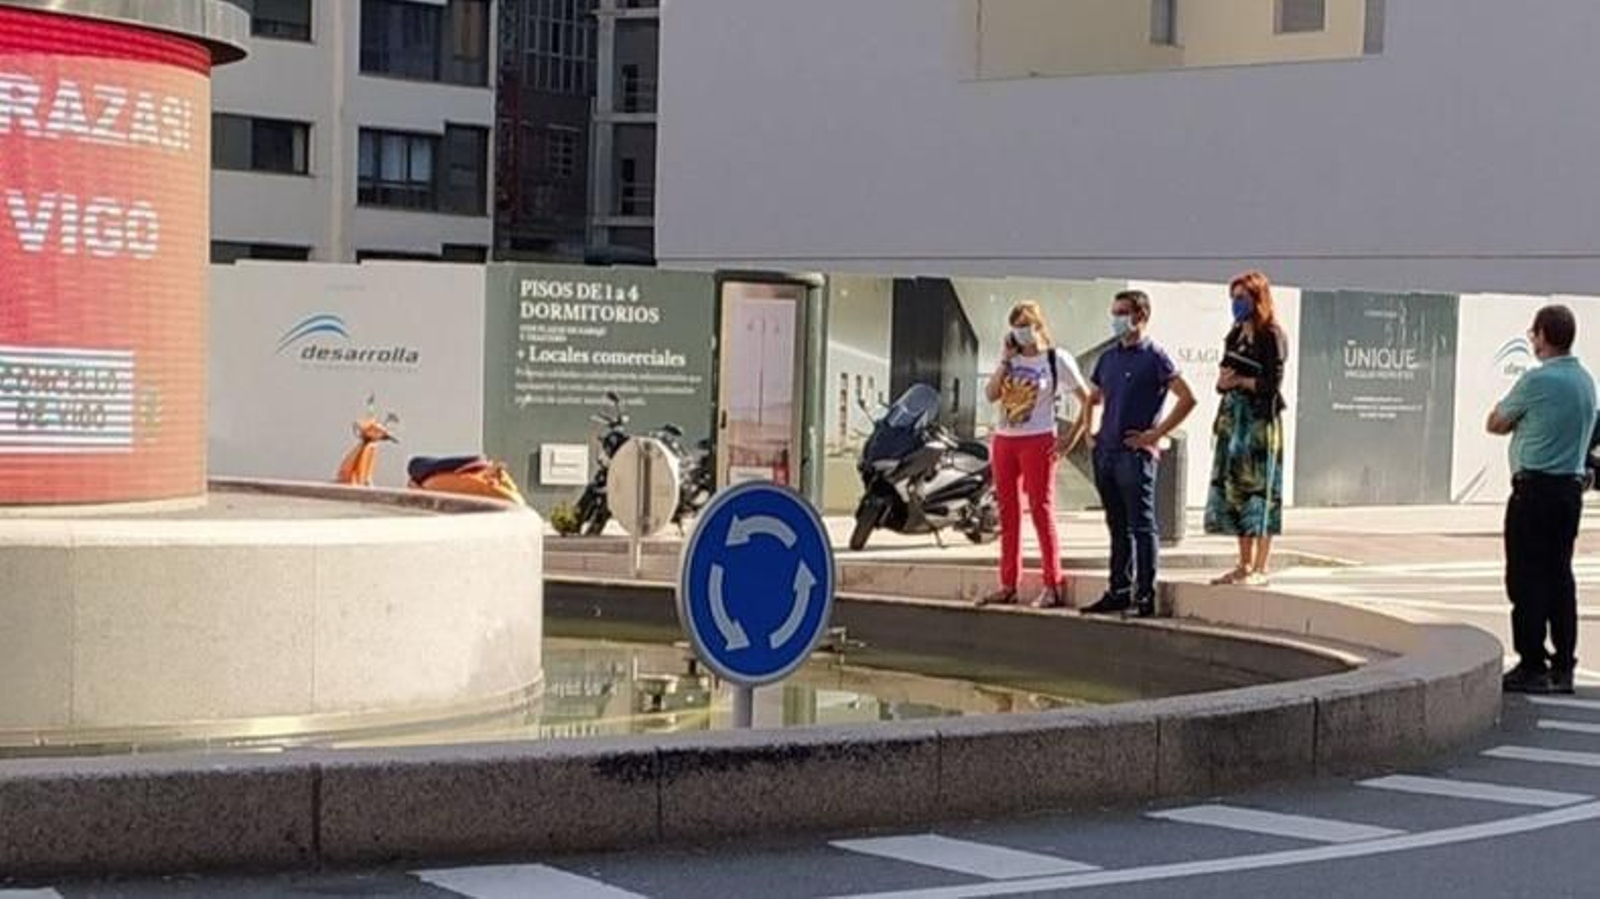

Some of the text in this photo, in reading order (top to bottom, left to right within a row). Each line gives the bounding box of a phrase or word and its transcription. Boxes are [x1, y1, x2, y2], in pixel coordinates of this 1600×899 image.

[6, 188, 159, 259] VIGO
[520, 280, 573, 299] PISOS
[576, 283, 602, 300] DE
[615, 288, 625, 301] a
[627, 285, 640, 302] 4
[520, 301, 660, 324] DORMITORIOS
[300, 344, 419, 364] desarrolla
[528, 345, 590, 365] Locales
[591, 349, 687, 368] comerciales
